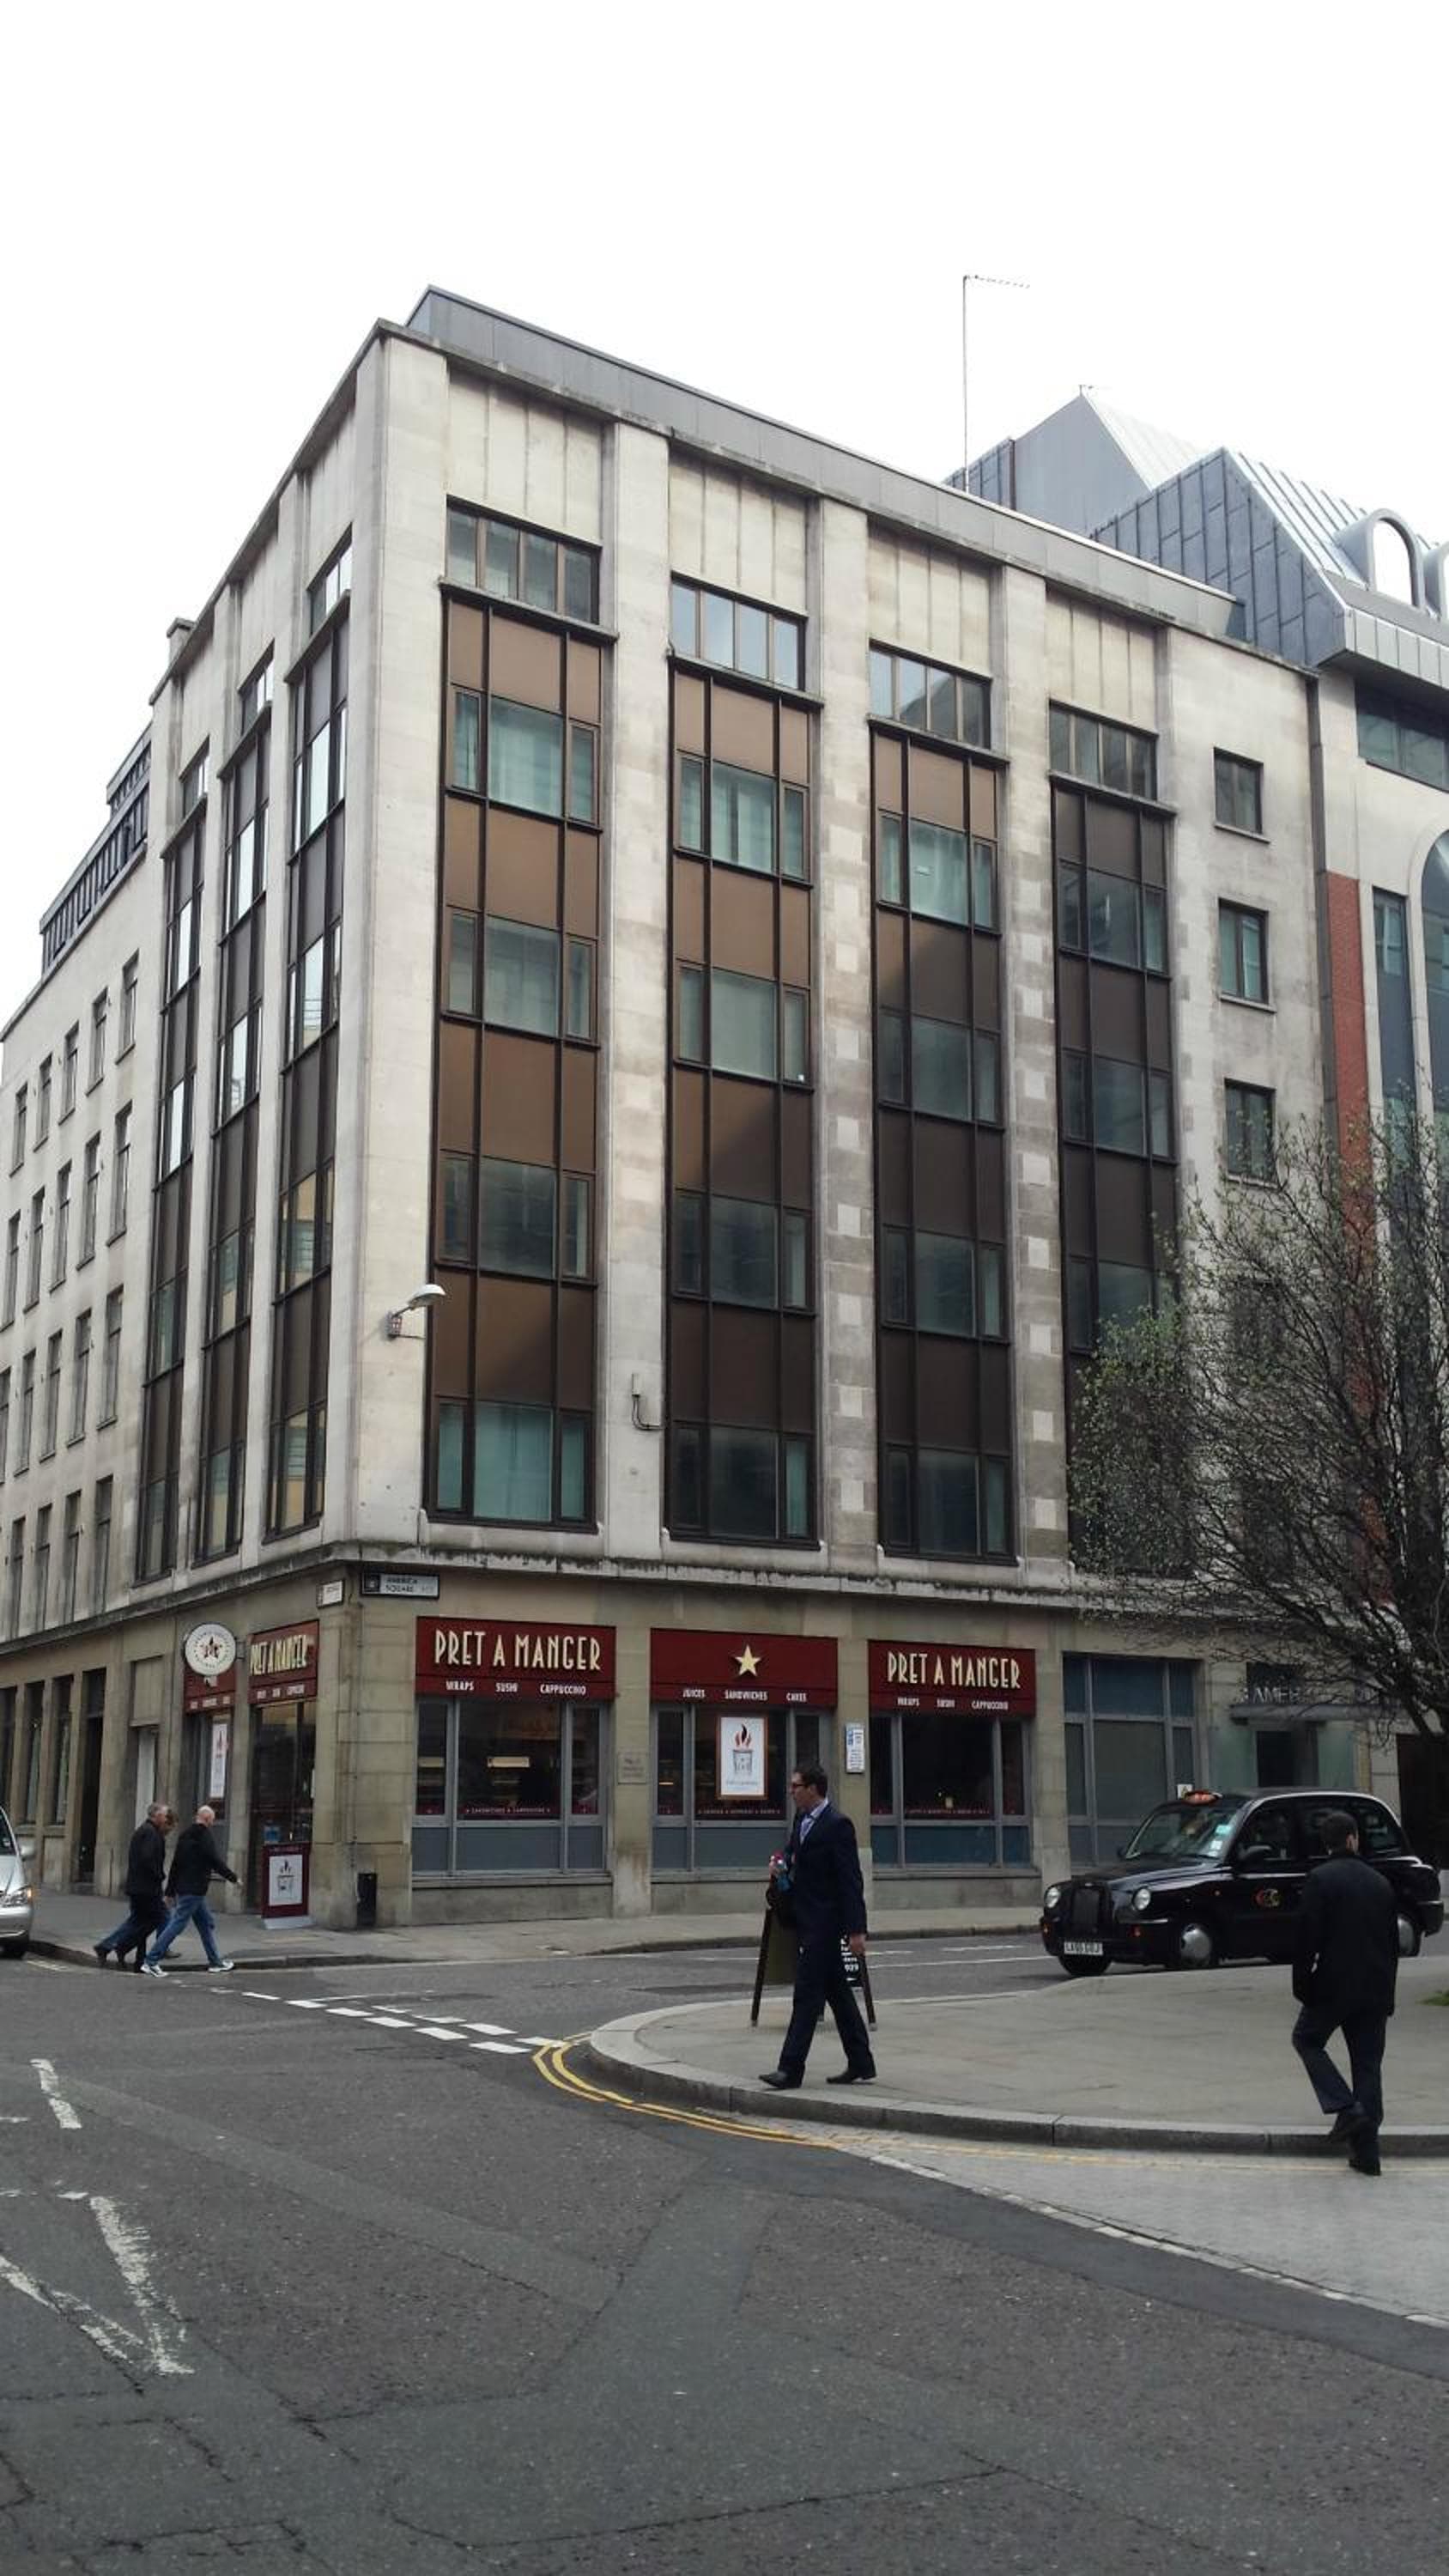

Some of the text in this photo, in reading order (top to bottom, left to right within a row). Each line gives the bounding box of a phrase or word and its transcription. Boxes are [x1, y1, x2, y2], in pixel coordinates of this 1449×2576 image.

[385, 1584, 414, 1593] SQUARE
[435, 1630, 601, 1670] PRET A MANGER
[888, 1651, 1021, 1689] PRET A MANGER
[446, 1680, 586, 1696] WRAPS SUSHI CAPPUCCINO
